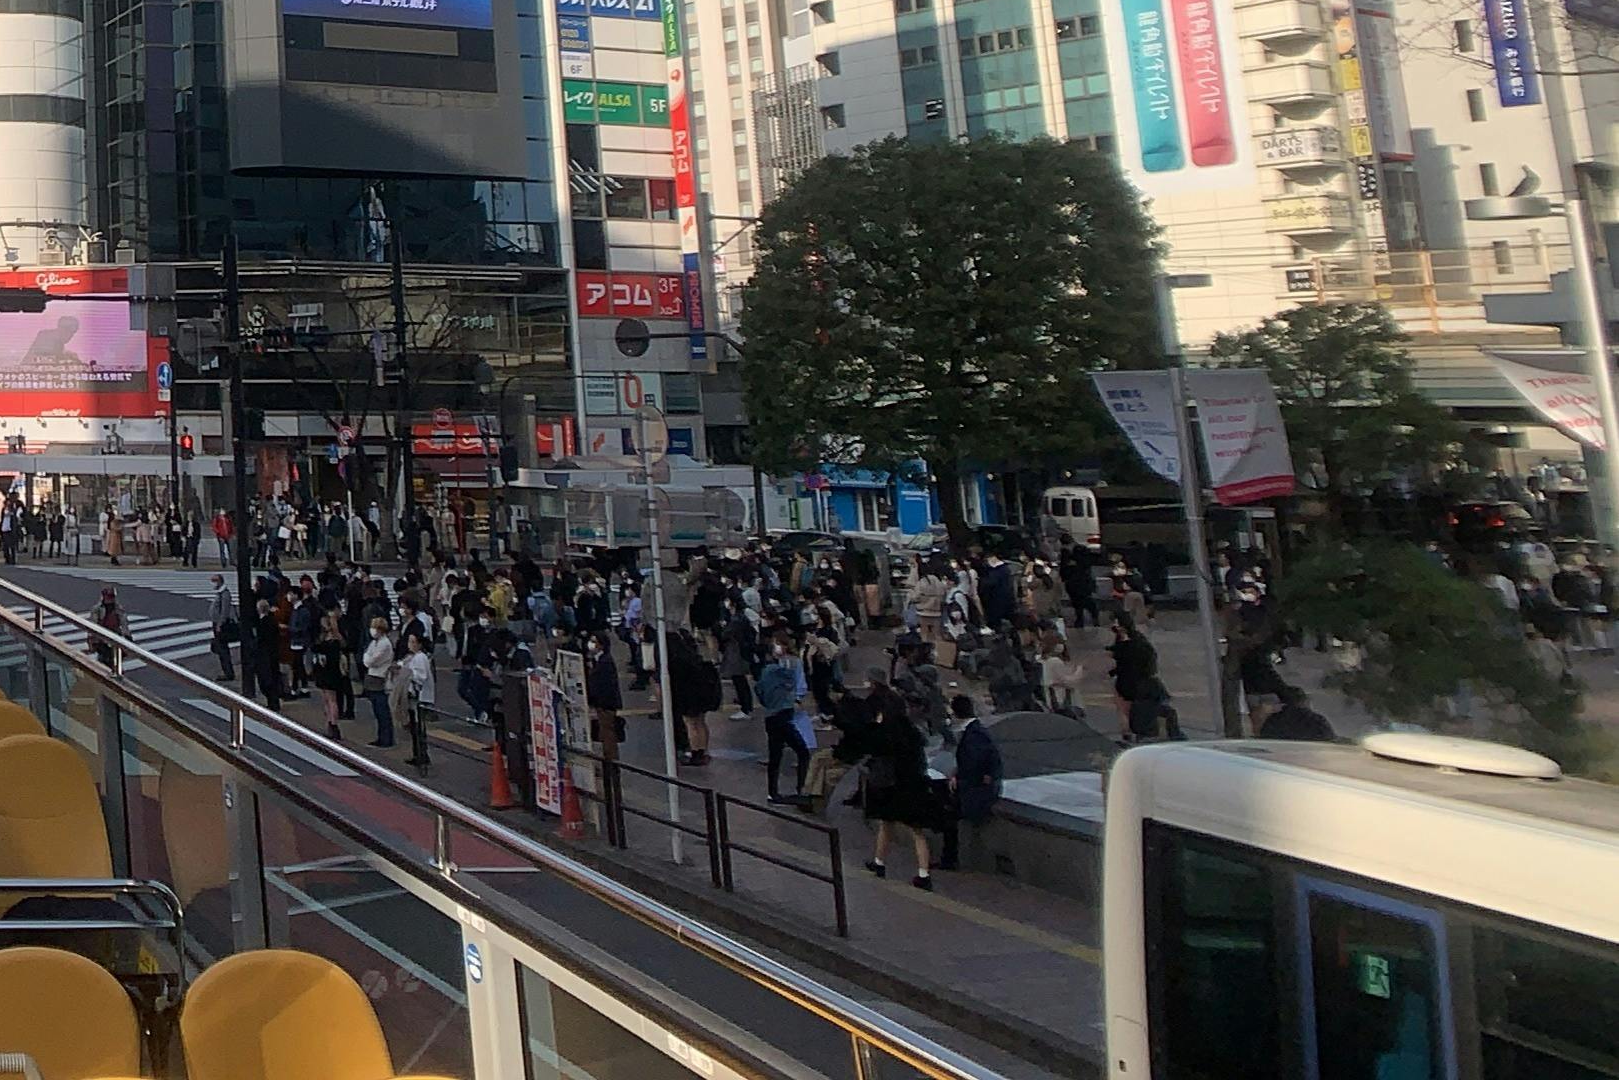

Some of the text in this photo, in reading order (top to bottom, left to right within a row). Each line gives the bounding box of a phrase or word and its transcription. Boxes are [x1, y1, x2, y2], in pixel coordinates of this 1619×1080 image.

[570, 64, 582, 74] 6F
[563, 91, 632, 107] レイク ALSA
[650, 99, 666, 112] 5F
[1262, 135, 1303, 150] DARTS
[675, 130, 689, 173] アコム
[1280, 146, 1304, 158] BAR
[36, 273, 80, 290] Glico
[659, 278, 679, 294] 3F
[587, 283, 652, 306] アコム
